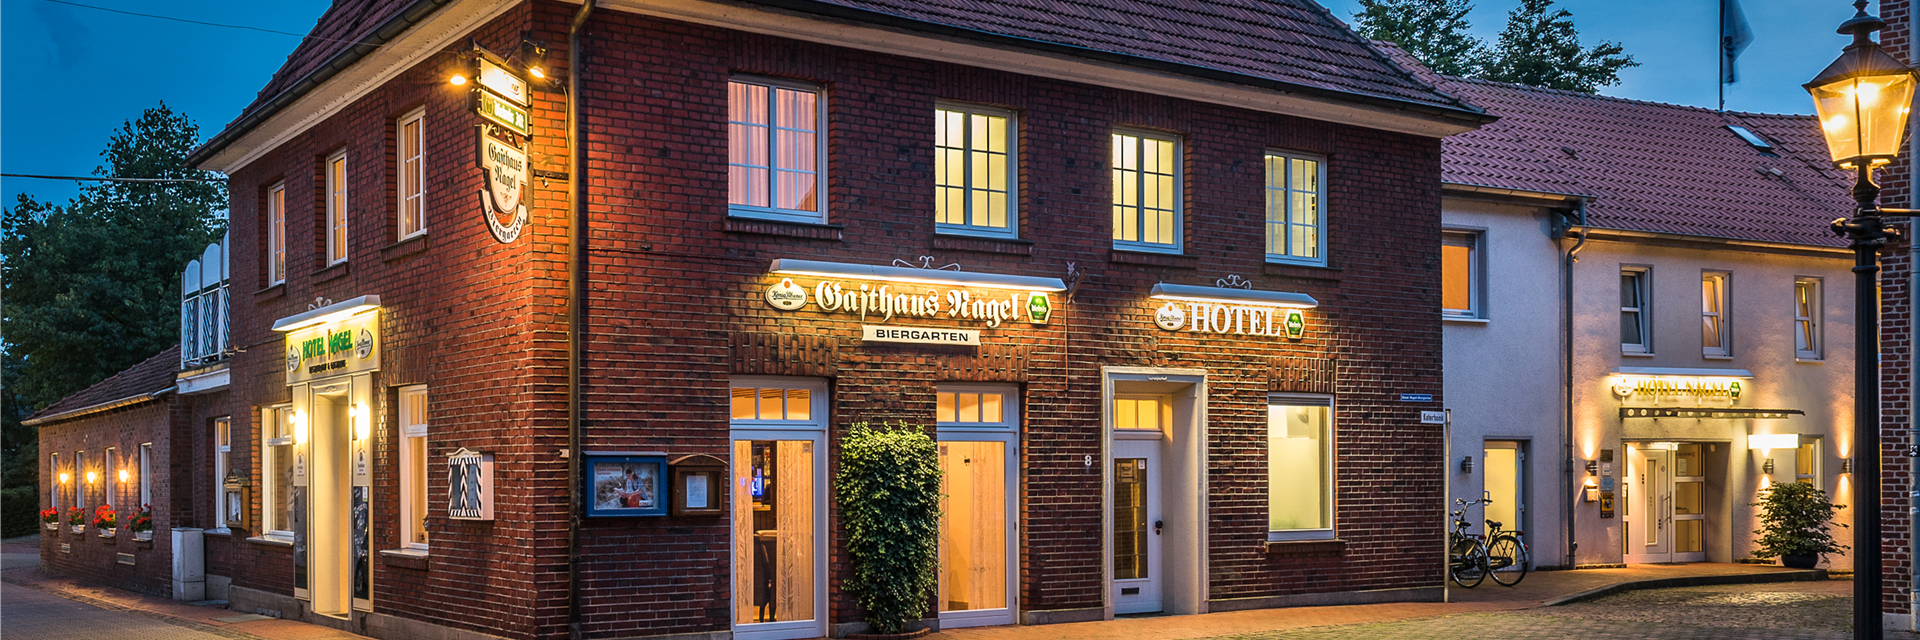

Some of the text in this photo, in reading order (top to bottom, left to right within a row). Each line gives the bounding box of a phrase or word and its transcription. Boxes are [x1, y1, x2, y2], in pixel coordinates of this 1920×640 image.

[494, 165, 516, 192] Nagel
[947, 289, 1020, 328] Nagel
[1188, 302, 1281, 337] HOTEL
[303, 337, 326, 361] HOTEL
[329, 330, 352, 354] NAGEL
[876, 329, 969, 342] BIERGARTEN
[1637, 379, 1730, 397] HOTEL NAGEL
[1084, 455, 1092, 466] 8
